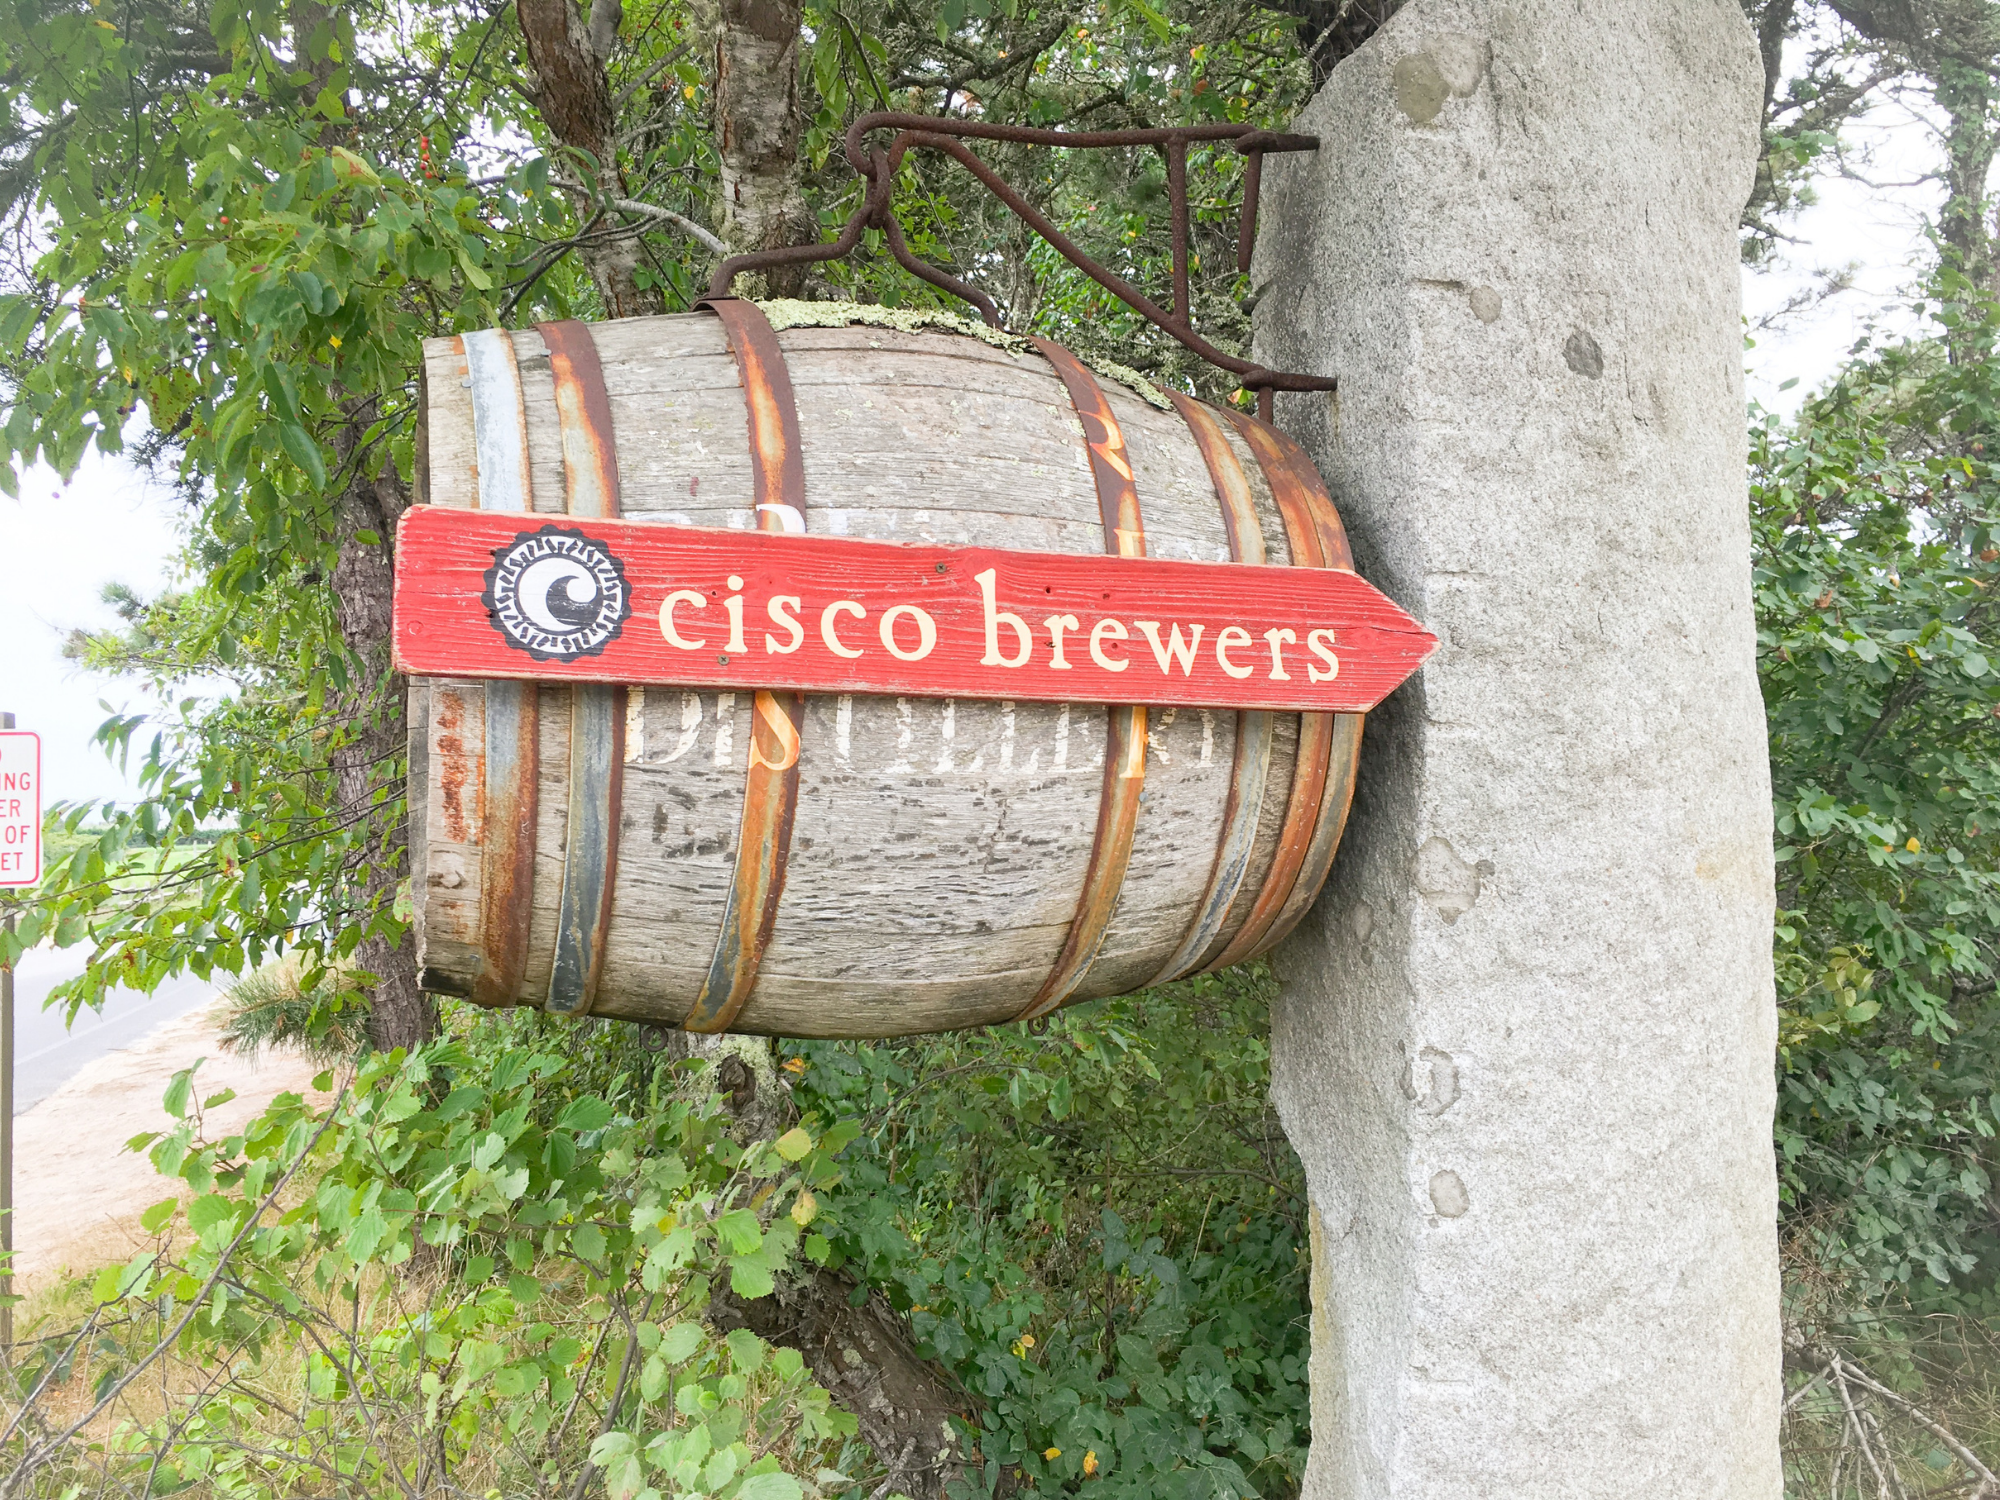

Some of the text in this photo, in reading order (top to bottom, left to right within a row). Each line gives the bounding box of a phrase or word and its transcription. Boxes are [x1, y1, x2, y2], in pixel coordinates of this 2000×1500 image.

[658, 567, 1341, 684] cisco brewers
[5, 825, 31, 844] OF
